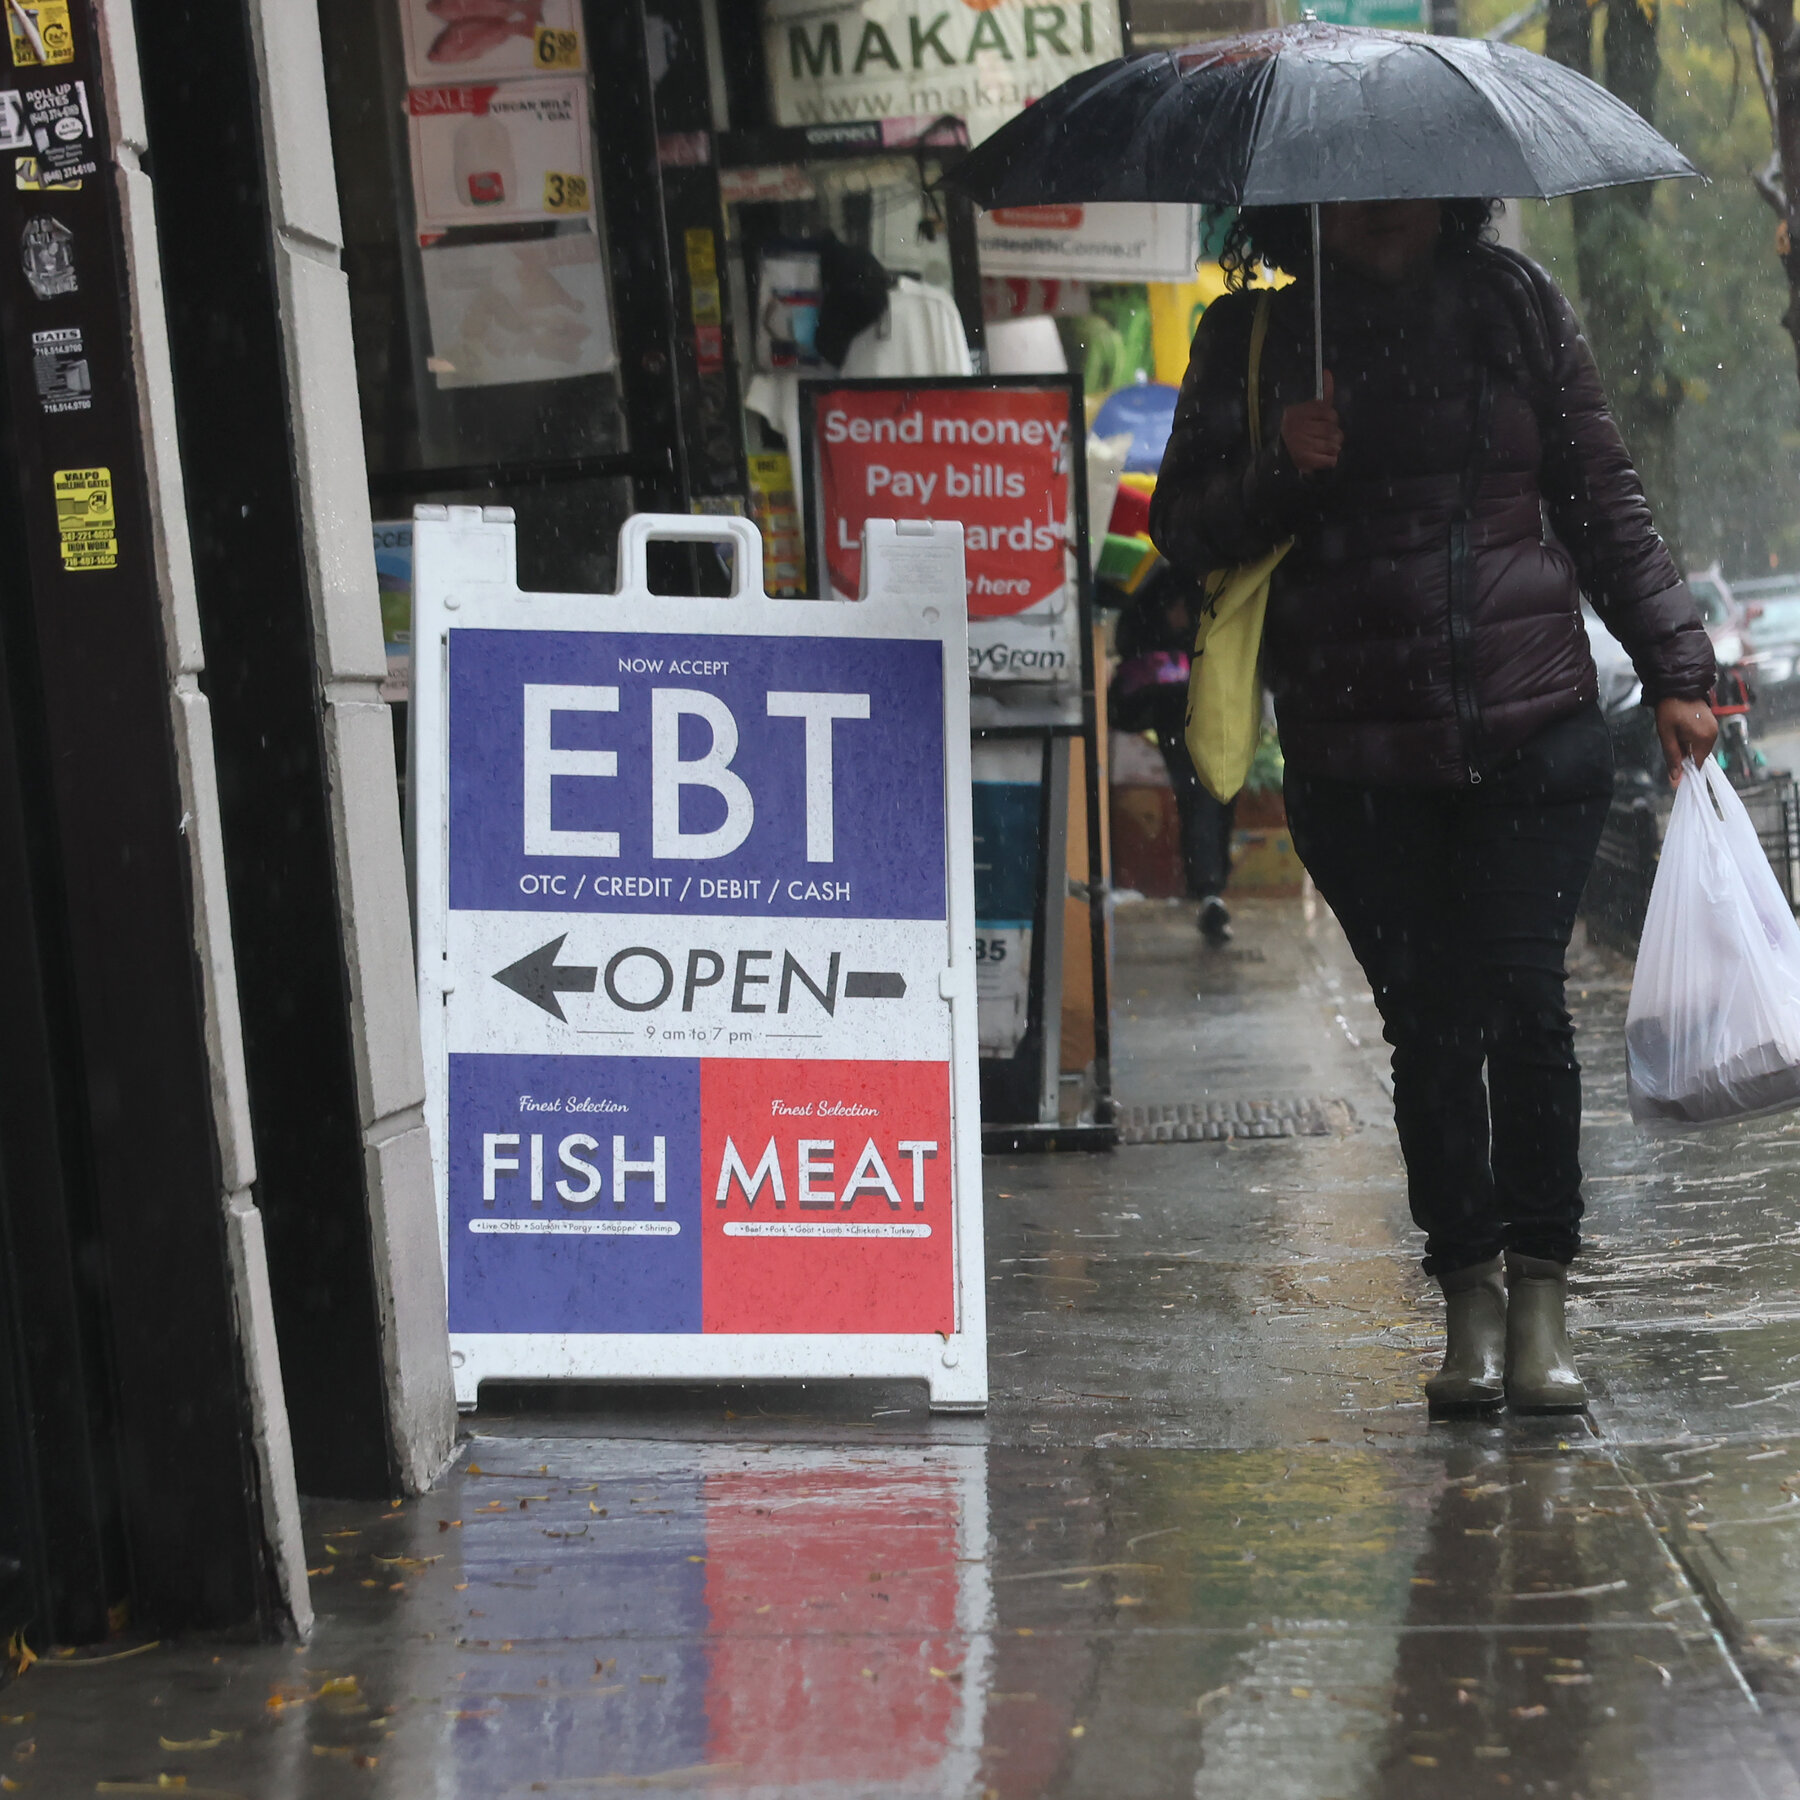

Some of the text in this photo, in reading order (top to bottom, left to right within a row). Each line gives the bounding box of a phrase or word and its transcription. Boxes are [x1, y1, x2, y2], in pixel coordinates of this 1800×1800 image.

[788, 1, 1096, 78] MAKARI
[26, 83, 71, 102] ROLL UP
[34, 95, 69, 110] GATES
[413, 89, 474, 112] SALE
[825, 410, 1067, 451] Send money
[65, 471, 99, 481] VALPO
[866, 463, 1025, 505] Pay bills
[967, 518, 1053, 550] ards
[975, 575, 1030, 595] here
[618, 657, 729, 676] NOW ACCEPT
[969, 643, 1065, 670] eyGram
[523, 683, 870, 863] EBT
[519, 874, 566, 895] OTC
[594, 877, 672, 898] CREDIT
[700, 879, 761, 900] DEBIT
[788, 881, 850, 902] CASH
[604, 946, 841, 1018] OPEN
[646, 1025, 752, 1045] 9 am to 7 pm
[519, 1095, 629, 1113] Finest Selection
[771, 1099, 880, 1117] Finest Selection
[483, 1133, 666, 1203] FISH
[715, 1135, 938, 1204] MEAT
[482, 1222, 498, 1230] Live
[569, 1224, 592, 1233] Porgy
[645, 1224, 673, 1234] Shrimp
[745, 1225, 762, 1233] Beef
[851, 1226, 880, 1234] Chicken
[891, 1227, 915, 1235] Turkey
